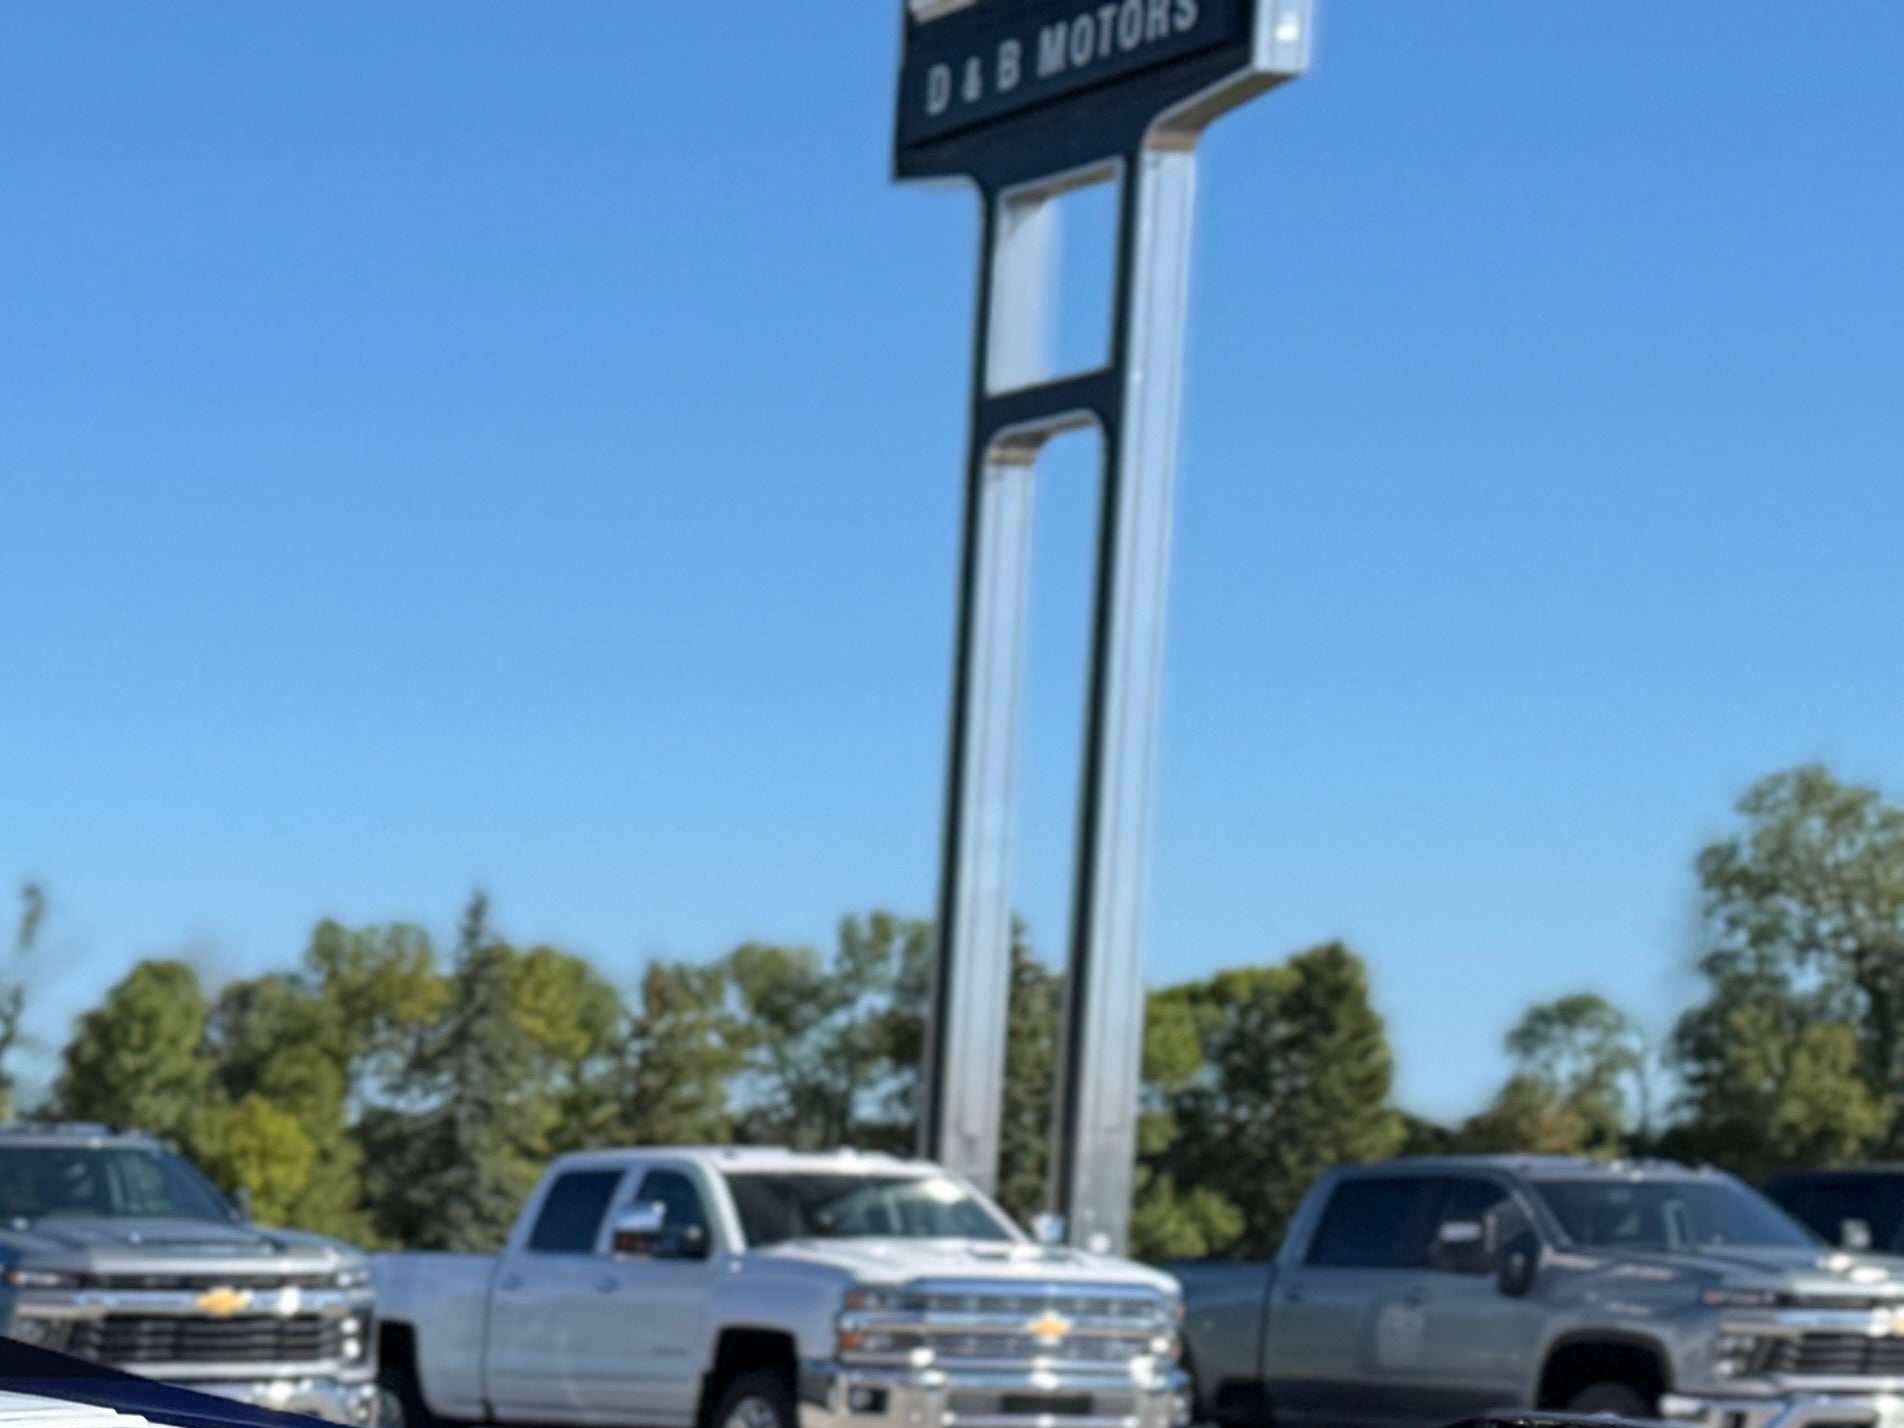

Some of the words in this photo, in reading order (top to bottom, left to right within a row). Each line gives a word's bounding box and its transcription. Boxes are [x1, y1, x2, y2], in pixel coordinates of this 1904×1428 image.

[925, 62, 951, 116] D
[962, 56, 982, 103] &
[996, 38, 1022, 92] B
[1037, 0, 1199, 78] MOTORS
